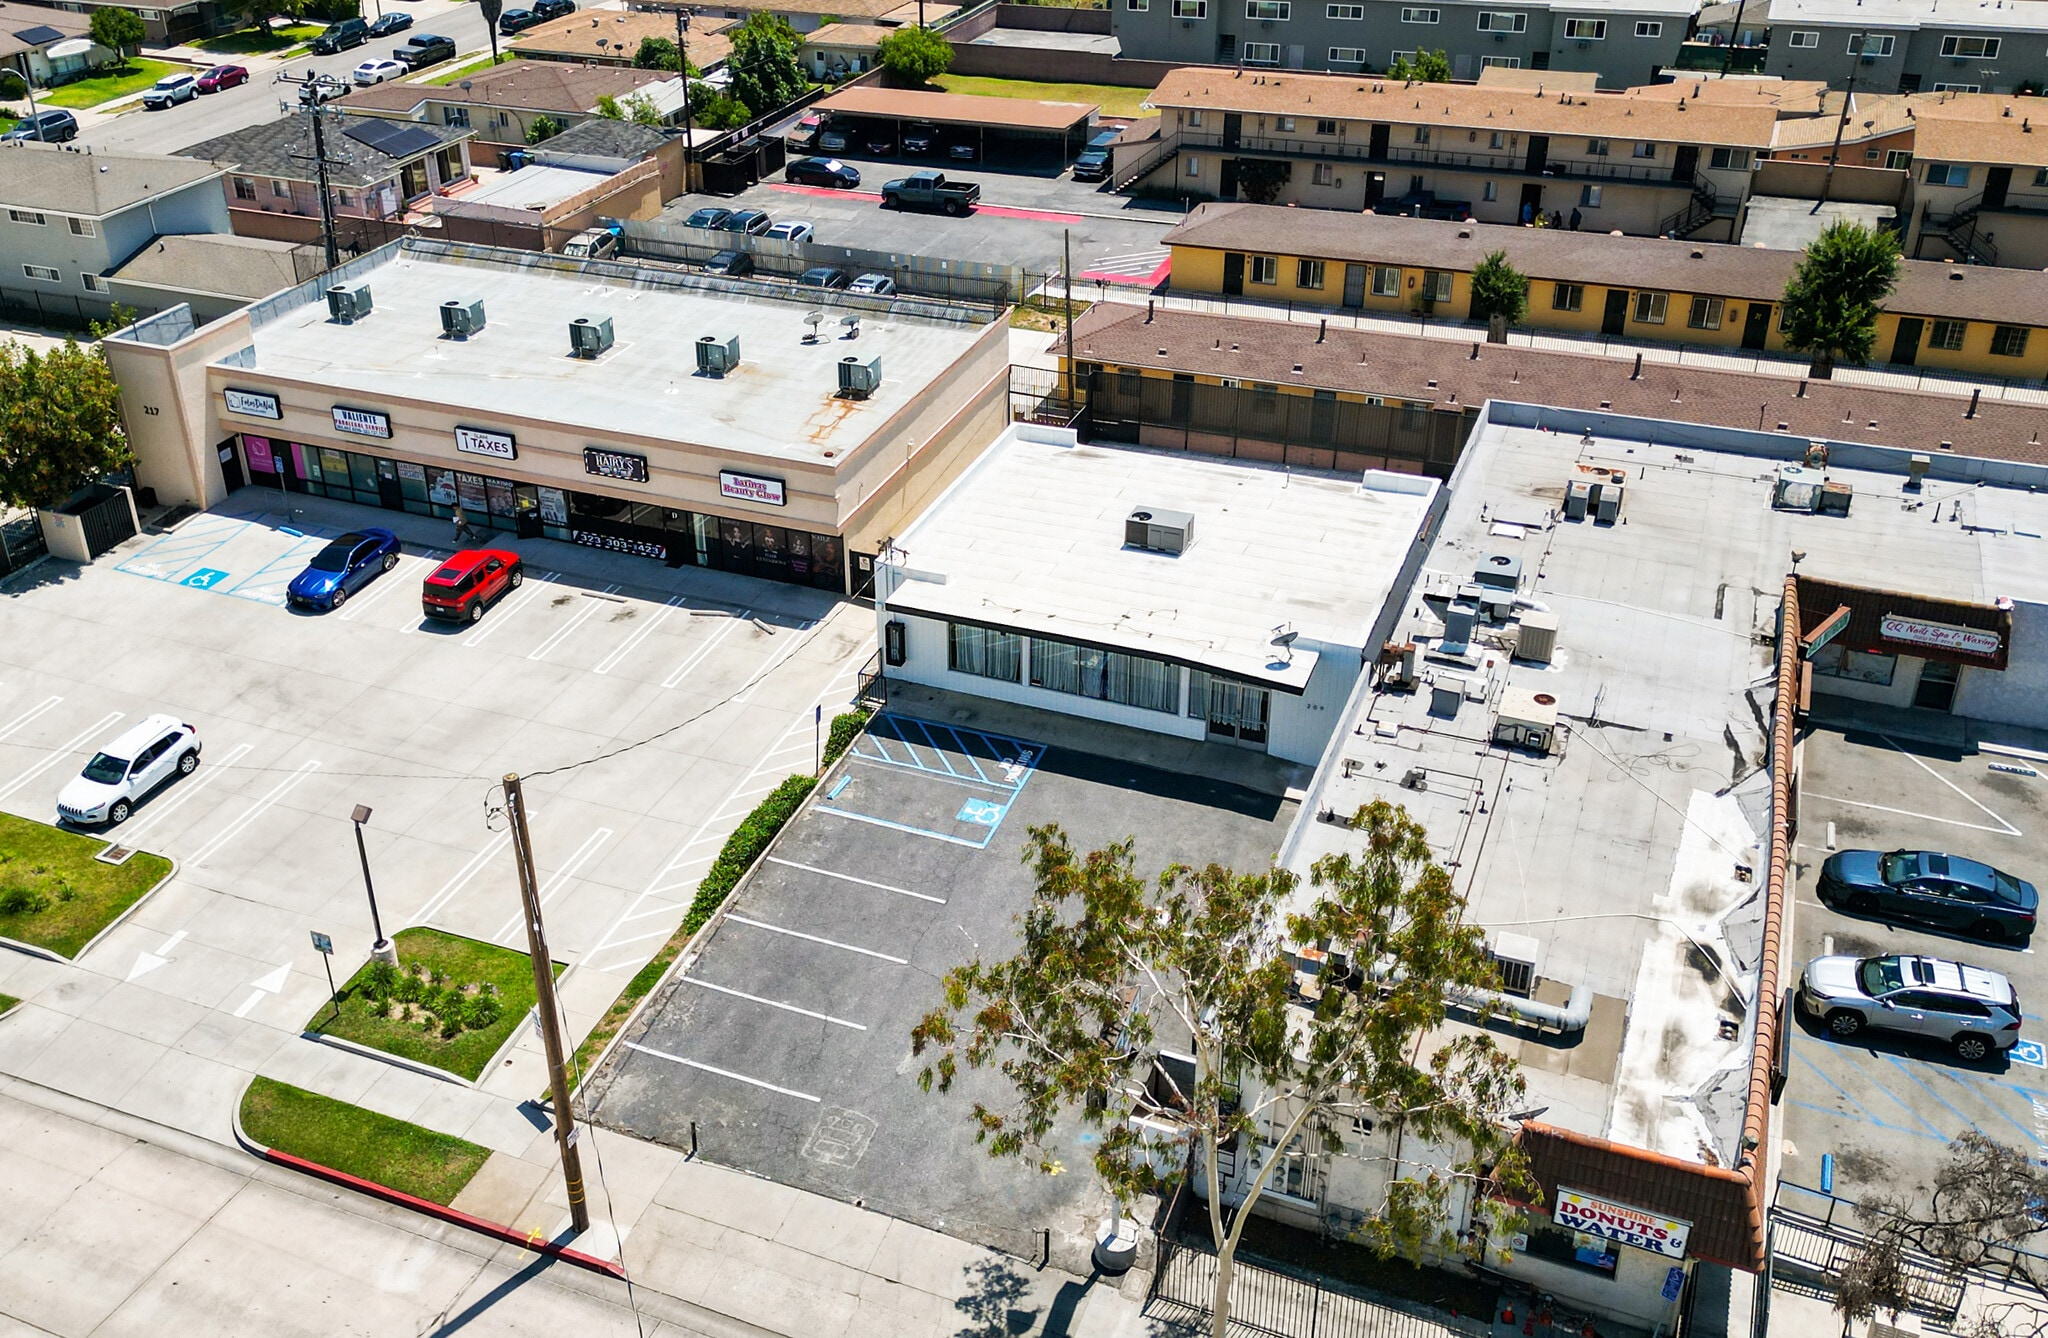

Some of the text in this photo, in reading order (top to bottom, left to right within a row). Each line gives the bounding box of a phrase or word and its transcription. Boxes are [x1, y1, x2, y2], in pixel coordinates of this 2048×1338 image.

[143, 405, 160, 416] 217
[341, 410, 377, 424] VALIENTE
[470, 437, 509, 453] TAXES
[456, 472, 484, 486] TAXES
[723, 484, 755, 498] Beauty
[1886, 621, 1903, 632] QQ
[1906, 625, 1929, 636] Nails
[1931, 628, 1949, 639] Spa
[1963, 634, 1998, 649] Waxing
[1590, 1200, 1657, 1226] SUNSHINE
[1560, 1201, 1683, 1248] DONUTS &
[1559, 1213, 1665, 1253] WATER
